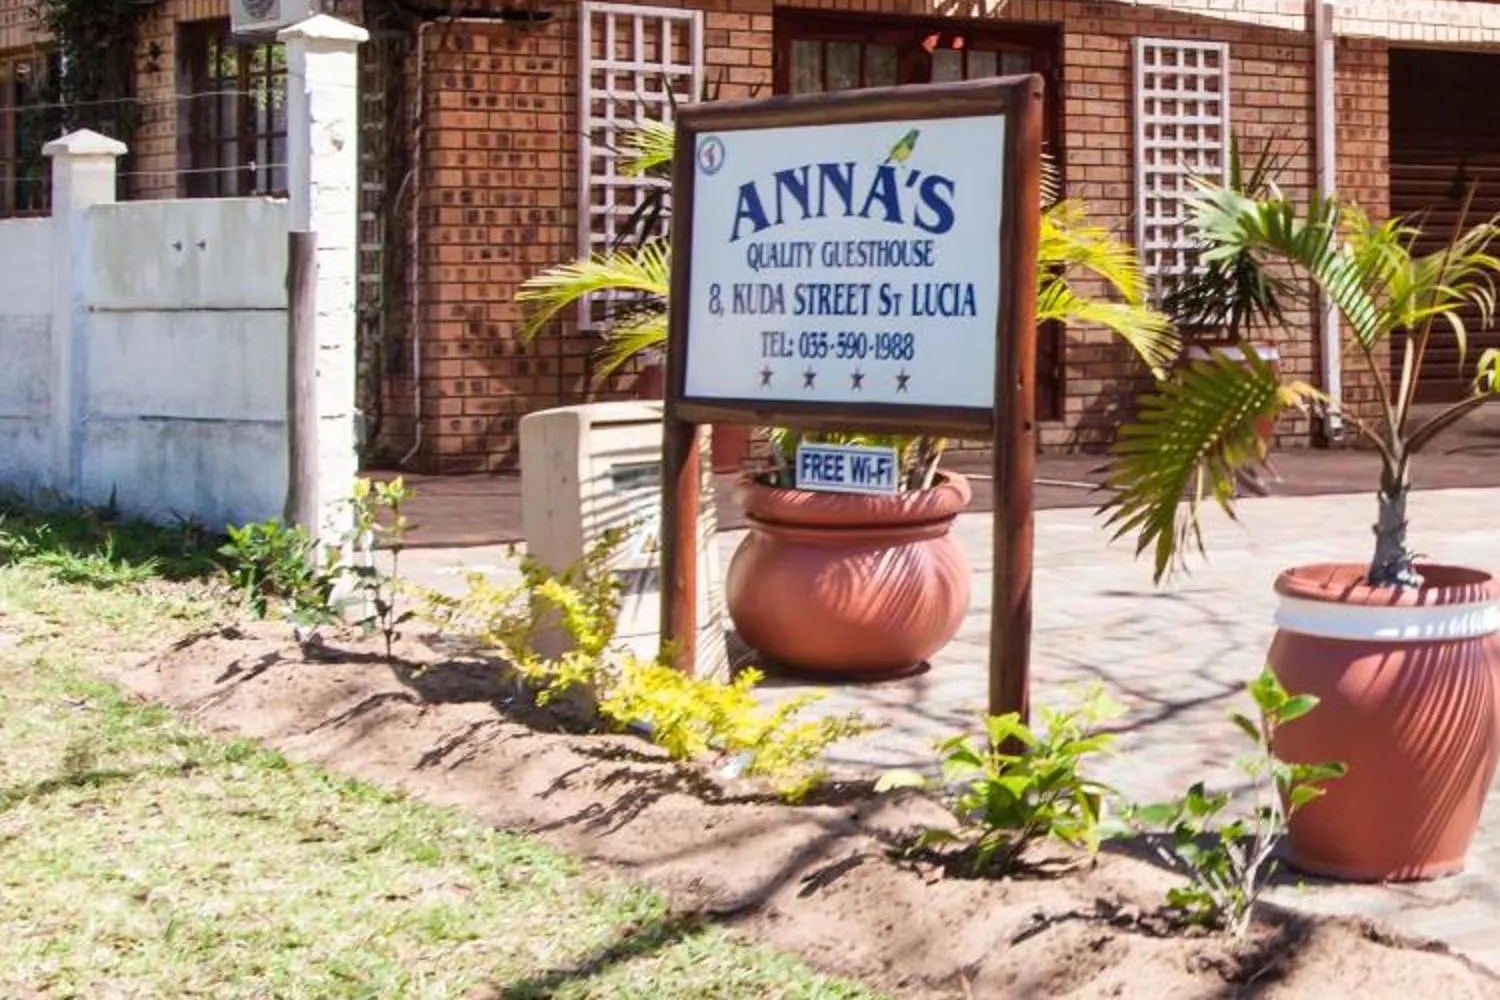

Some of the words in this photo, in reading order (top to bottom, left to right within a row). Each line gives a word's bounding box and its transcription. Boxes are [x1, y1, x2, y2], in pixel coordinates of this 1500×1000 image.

[729, 162, 956, 242] ANNA'S
[746, 241, 816, 272] QUALITY
[821, 239, 935, 267] GUESTHOUSE
[732, 284, 786, 315] KUDA
[793, 283, 870, 316] STREET
[911, 283, 977, 317] LUCIA
[761, 331, 794, 358] TEL:
[802, 453, 844, 481] FREE
